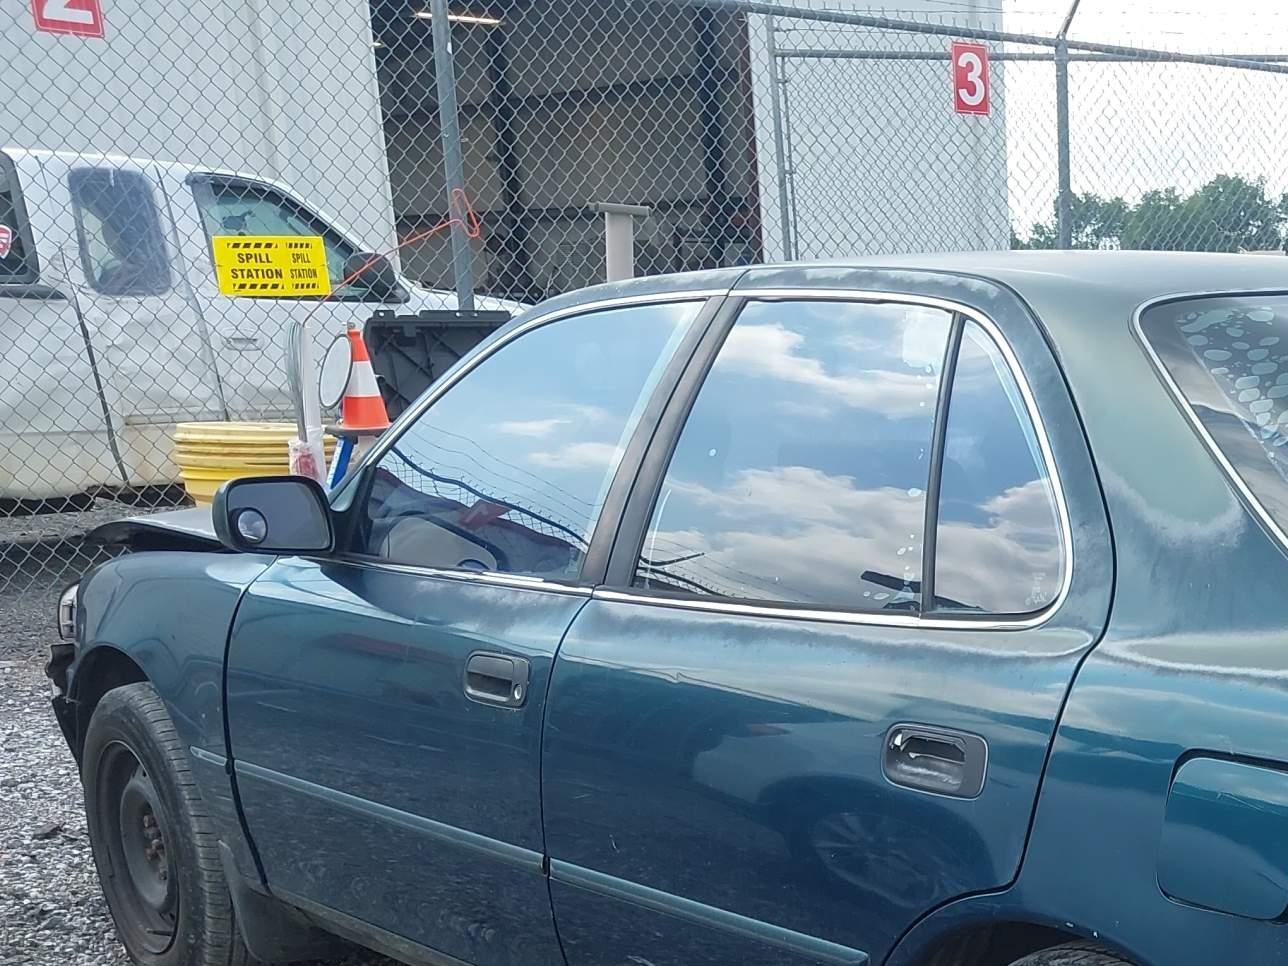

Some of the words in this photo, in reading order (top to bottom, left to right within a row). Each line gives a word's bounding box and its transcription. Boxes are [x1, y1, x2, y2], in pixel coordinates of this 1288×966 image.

[957, 52, 985, 105] 3
[237, 252, 272, 264] SPILL
[291, 252, 311, 264] SPILL
[231, 268, 283, 280] STATION
[290, 268, 318, 280] STATION
